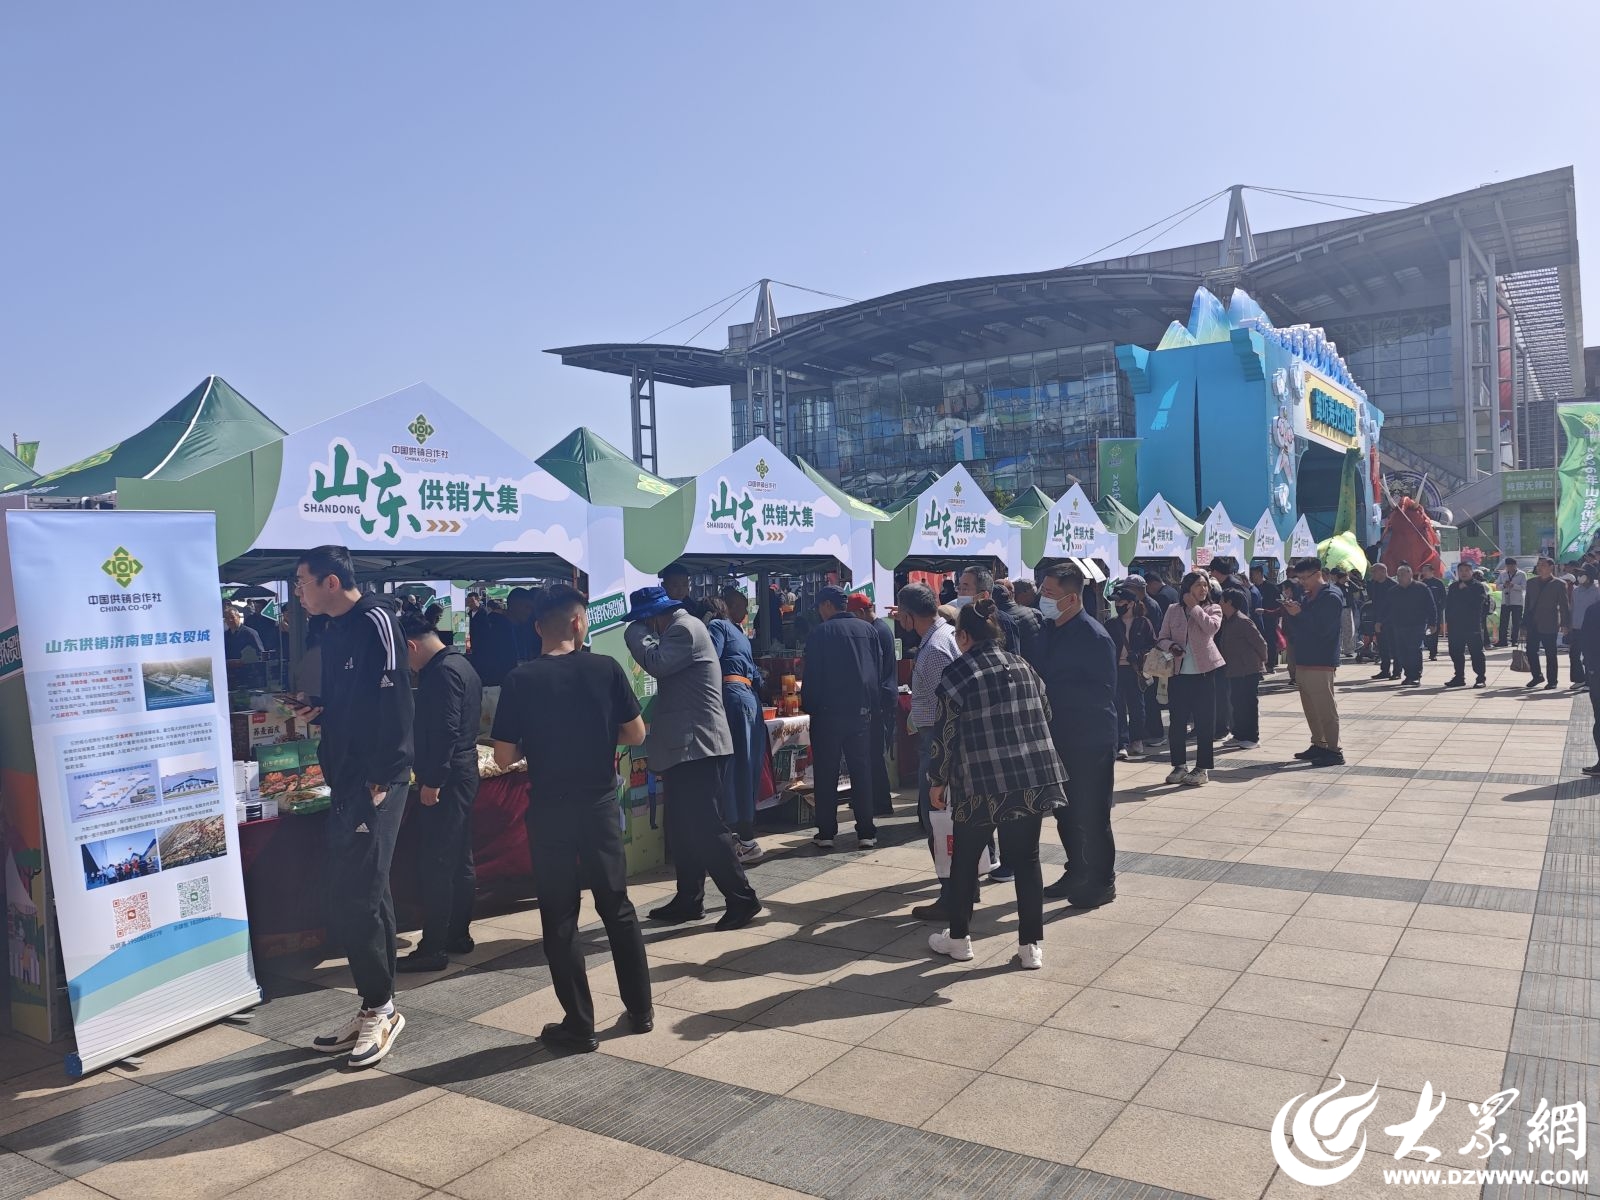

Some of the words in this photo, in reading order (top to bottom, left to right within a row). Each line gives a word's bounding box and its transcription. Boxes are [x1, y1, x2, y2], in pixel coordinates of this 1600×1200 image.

[392, 446, 448, 458] 中国供销合作社
[418, 479, 519, 514] 供销大集
[304, 503, 361, 515] SHANDONG
[762, 503, 814, 528] 供销大集
[88, 592, 162, 605] 中国供销合作社
[100, 605, 127, 613] CHINA
[45, 629, 211, 654] 山东供销济南智慧农贸城
